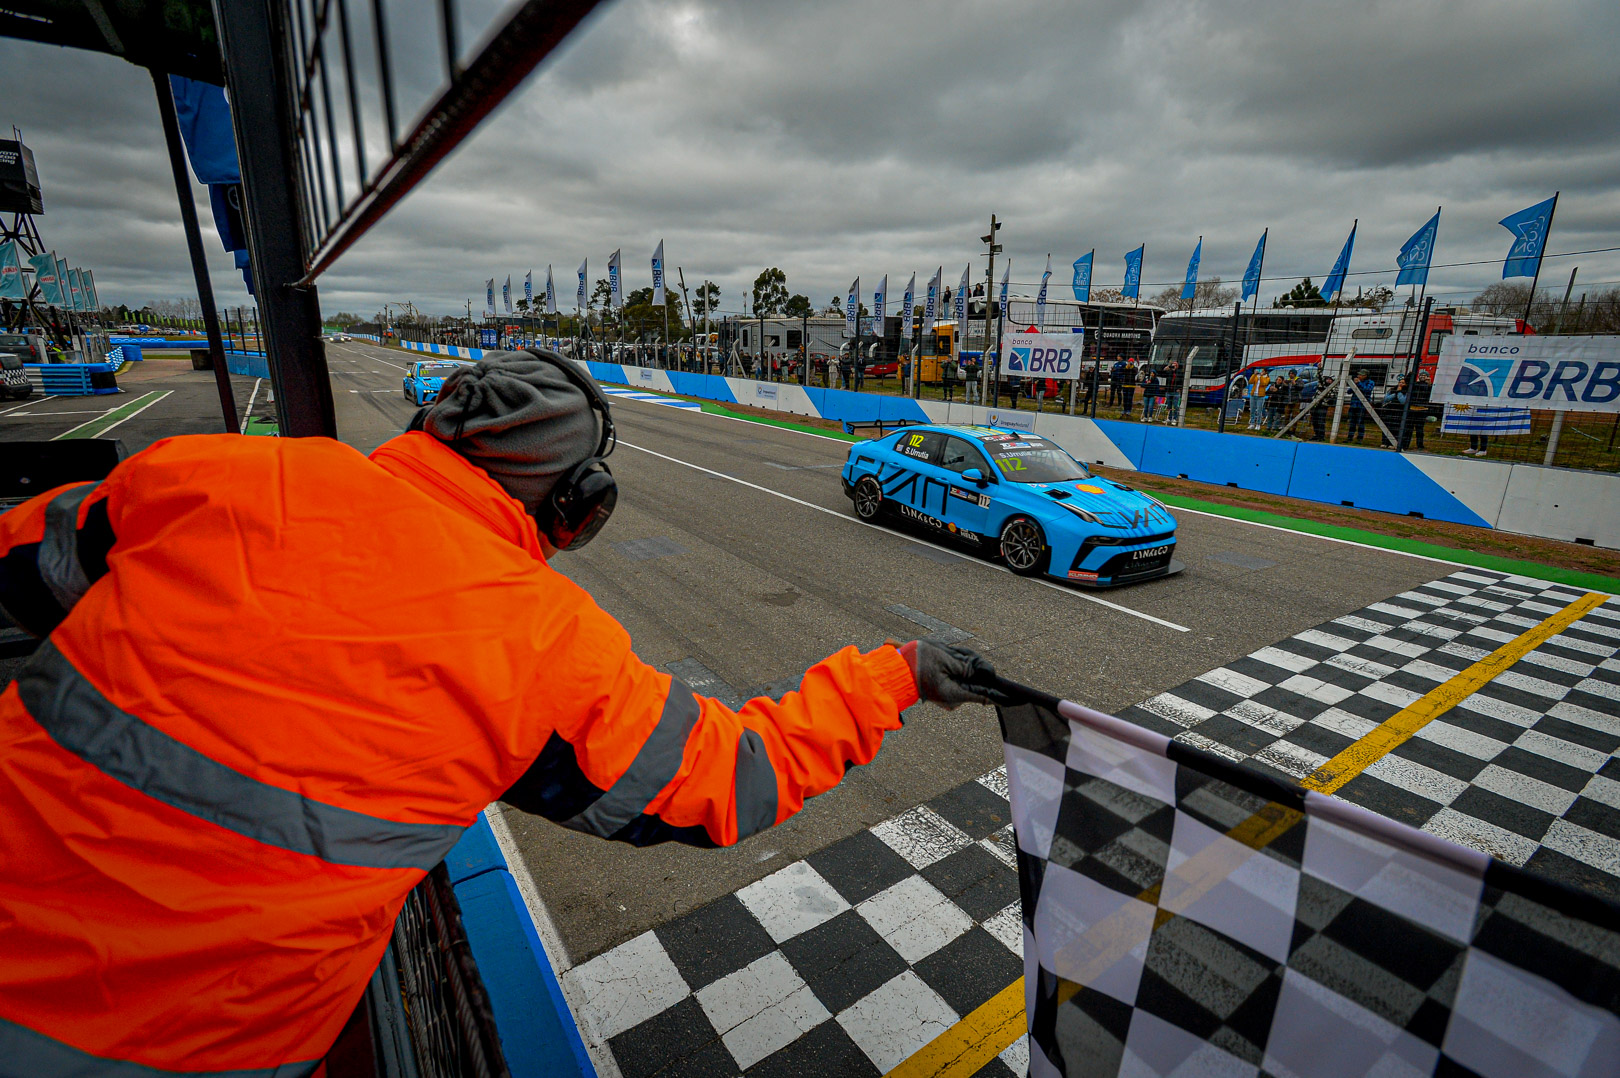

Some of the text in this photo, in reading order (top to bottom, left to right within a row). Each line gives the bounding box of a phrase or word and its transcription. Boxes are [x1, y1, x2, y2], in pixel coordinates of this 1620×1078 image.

[609, 275, 617, 293] BRB
[653, 269, 662, 288] BRB
[847, 304, 856, 322] BRB
[874, 303, 882, 322] BRB
[903, 303, 912, 322] BRB
[925, 298, 935, 318] BRB
[955, 297, 964, 319] BRB
[1467, 343, 1520, 355] banco
[1029, 347, 1073, 373] BRB
[1507, 359, 1620, 403] BRB
[909, 434, 925, 448] 112
[904, 446, 929, 460] S.Urrutia
[995, 457, 1028, 473] 112
